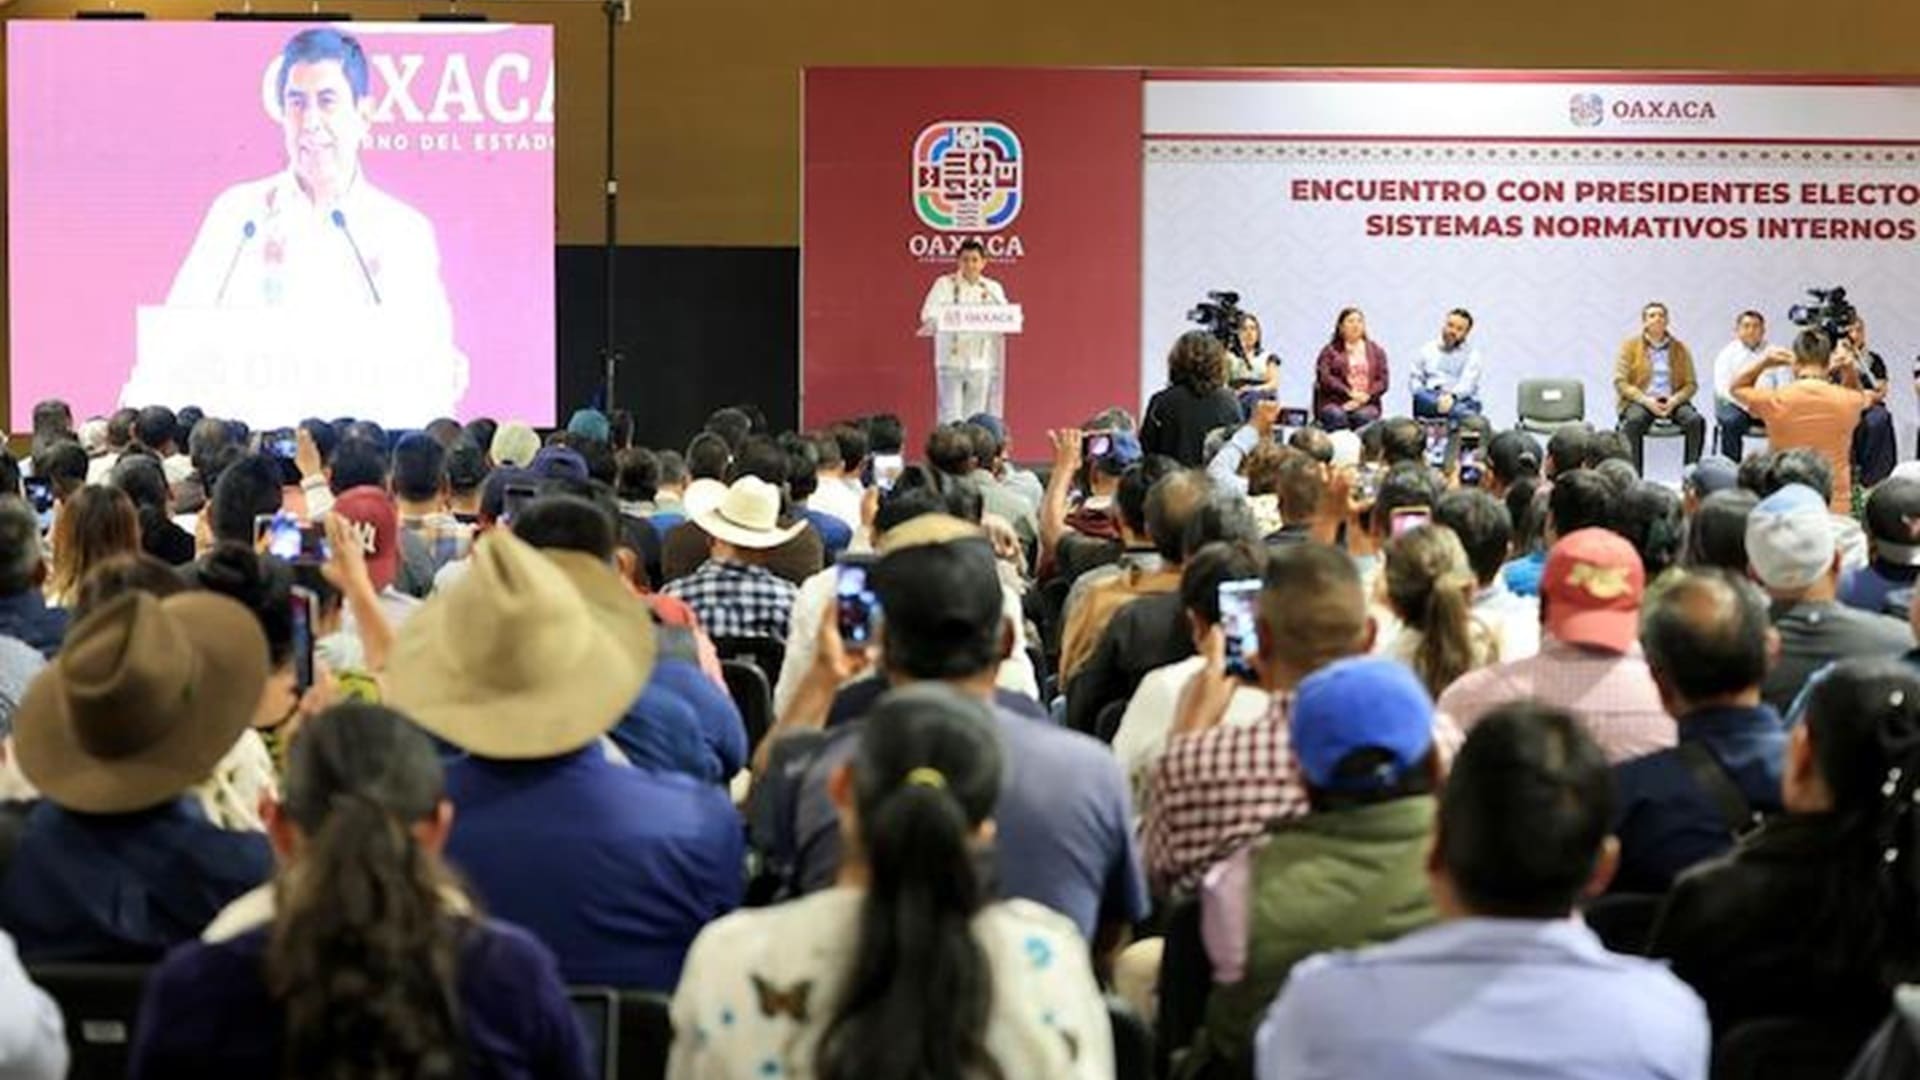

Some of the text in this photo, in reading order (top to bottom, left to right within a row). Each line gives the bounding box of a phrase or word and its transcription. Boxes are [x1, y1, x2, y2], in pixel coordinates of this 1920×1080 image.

[1612, 100, 1716, 119] OAXACA
[420, 133, 461, 150] DEL
[1291, 180, 1920, 206] ENCUENTRO CON PRESIDENTES ELECTO
[1366, 214, 1916, 241] SISTEMAS NORMATIVOS INTERNOS
